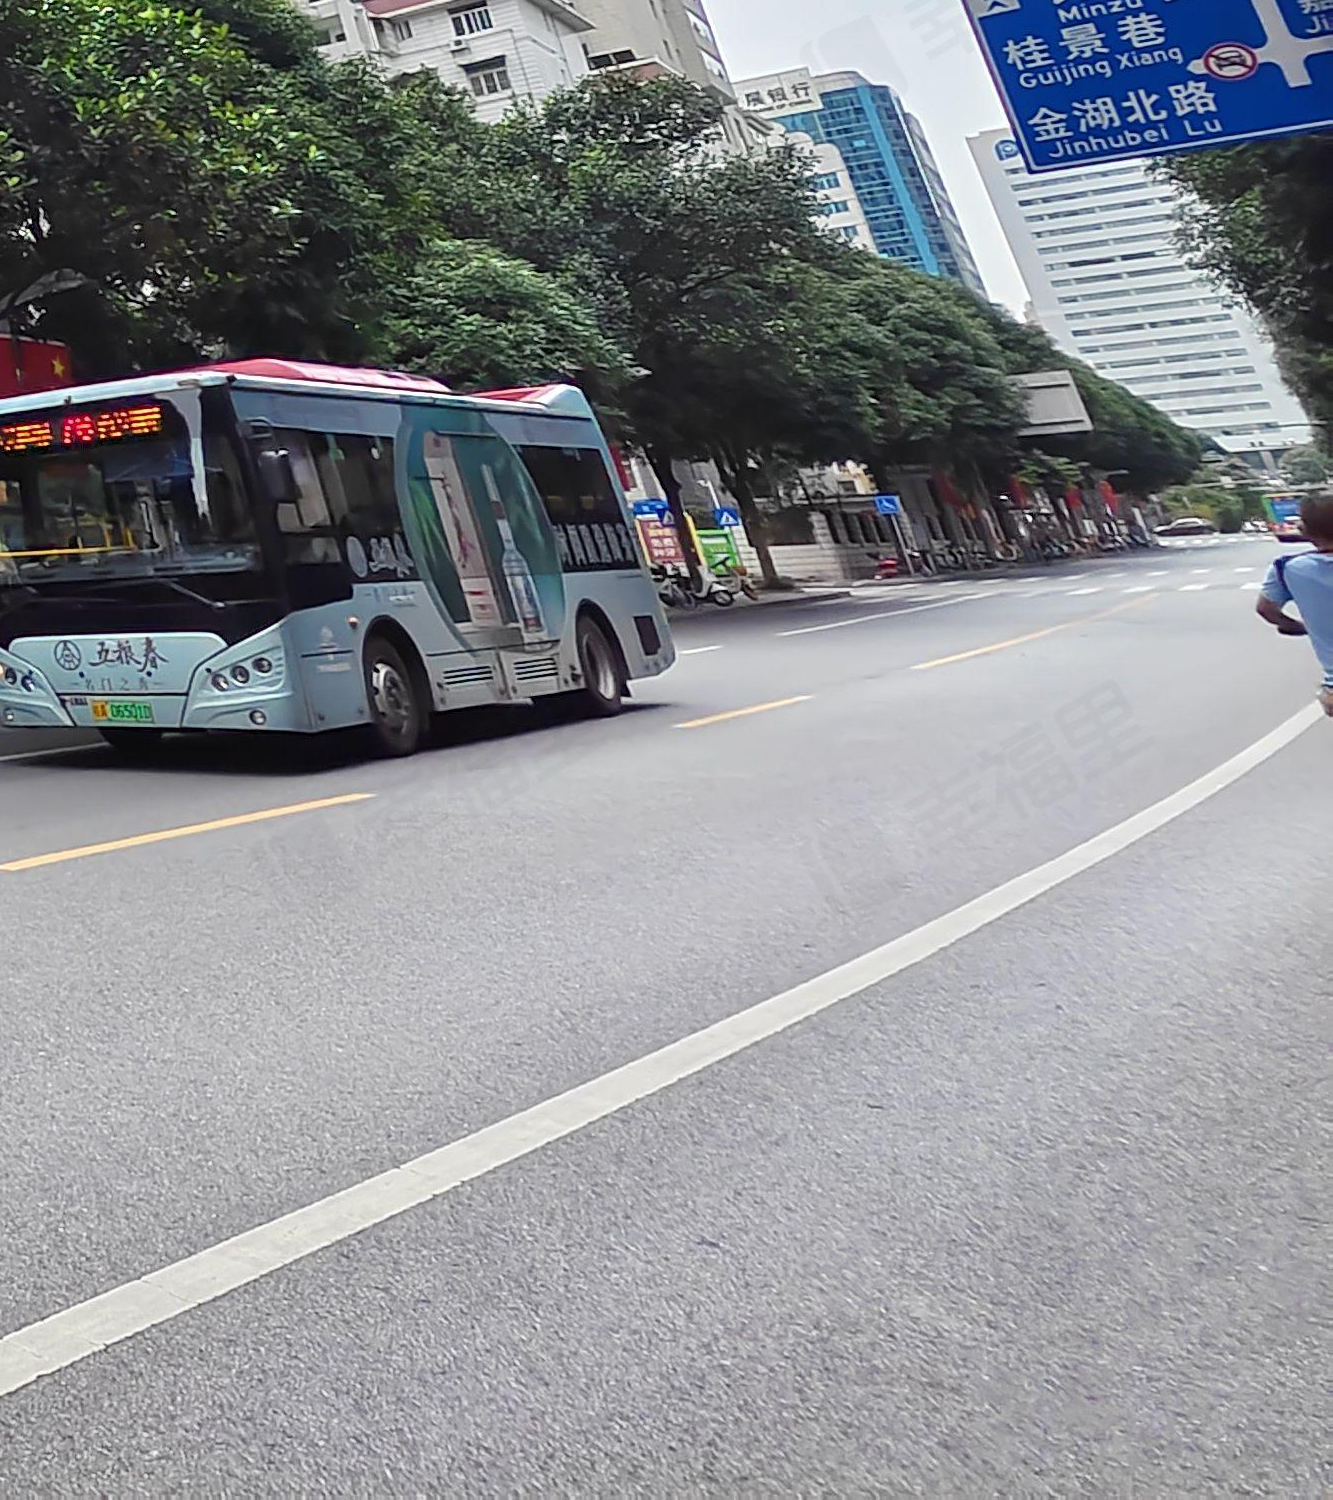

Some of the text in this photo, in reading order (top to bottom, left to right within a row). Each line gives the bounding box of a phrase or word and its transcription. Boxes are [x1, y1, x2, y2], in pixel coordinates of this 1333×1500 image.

[1002, 12, 1166, 71] 桂景巷
[1019, 47, 1183, 88] Guijing Xiang
[1028, 80, 1218, 142] 金湖北路
[1048, 118, 1223, 158] Jinhubei Lu
[88, 636, 170, 673] 五粮春
